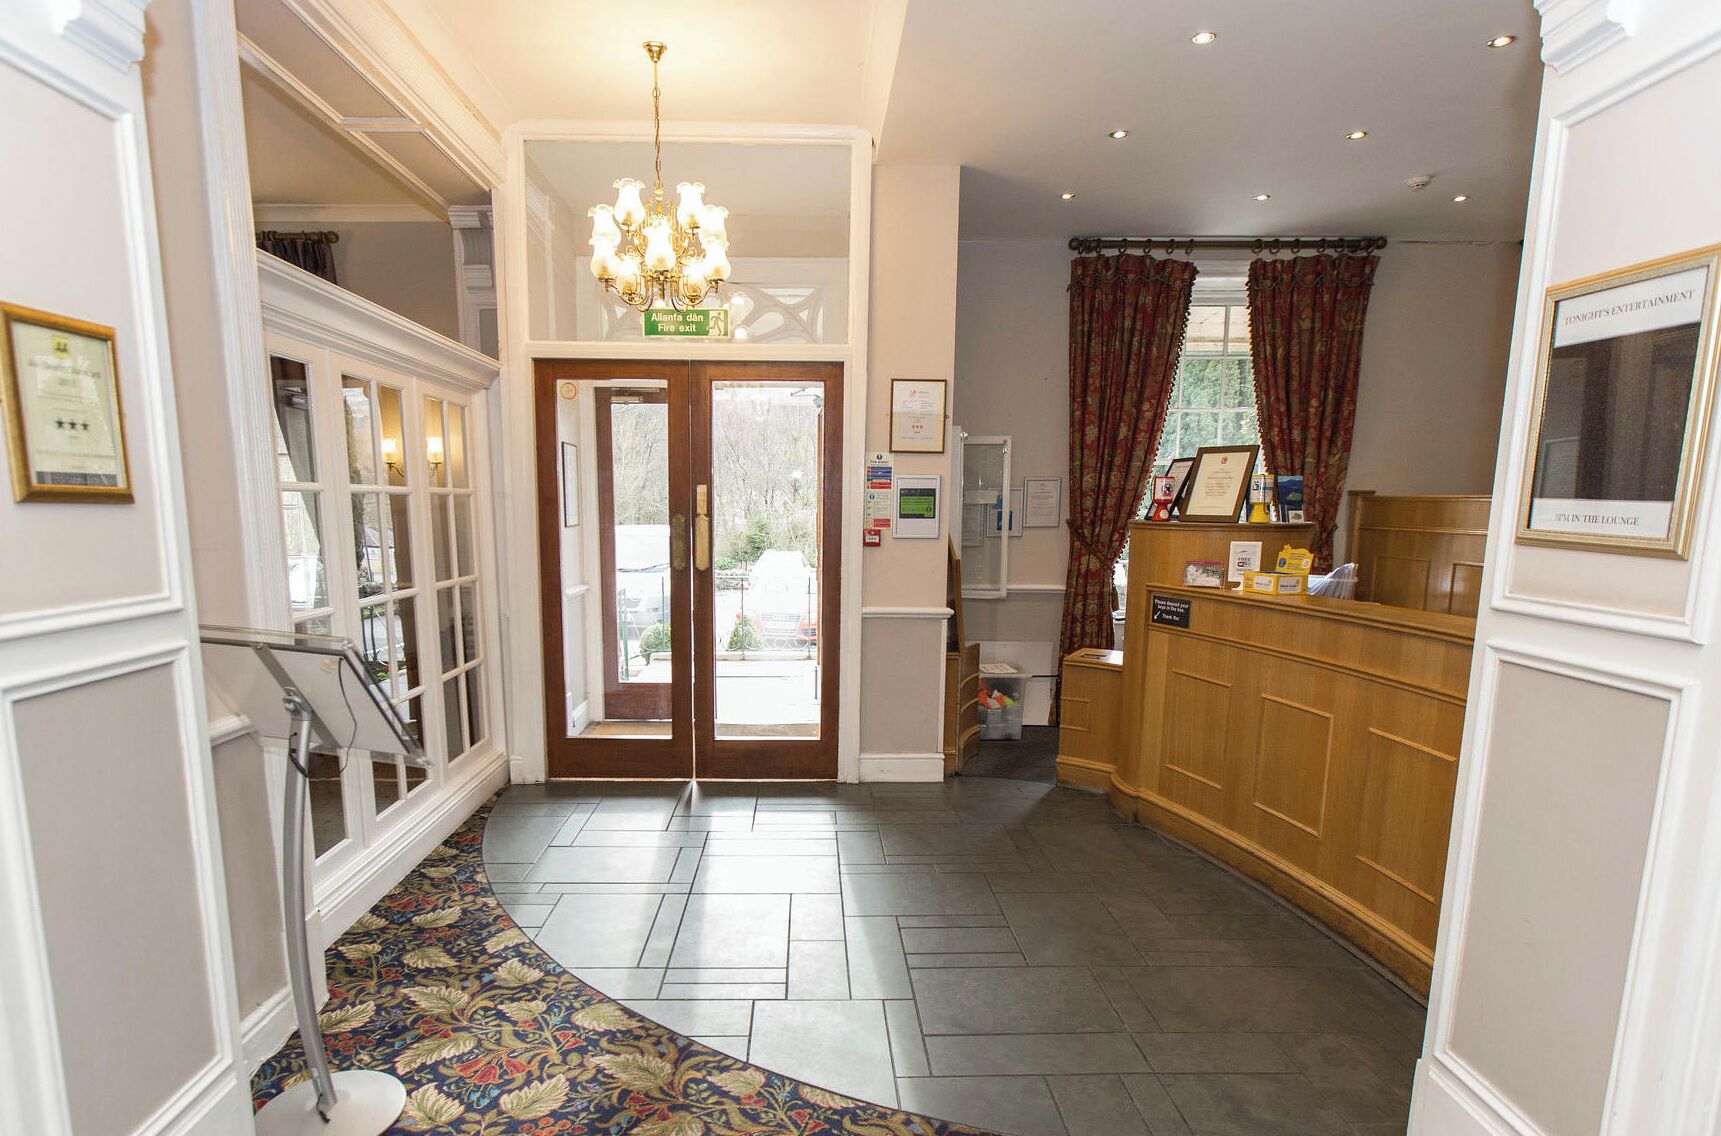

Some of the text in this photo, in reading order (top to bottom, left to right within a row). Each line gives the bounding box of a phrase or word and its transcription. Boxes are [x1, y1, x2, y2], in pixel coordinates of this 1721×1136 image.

[1563, 288, 1696, 326] TONIGHT'S ENTERTAINMENT
[651, 312, 683, 322] Allanfa
[658, 323, 696, 332] Fire exit
[1571, 514, 1581, 522] IN
[1583, 514, 1600, 524] THE
[1601, 515, 1640, 526] LOUNGE
